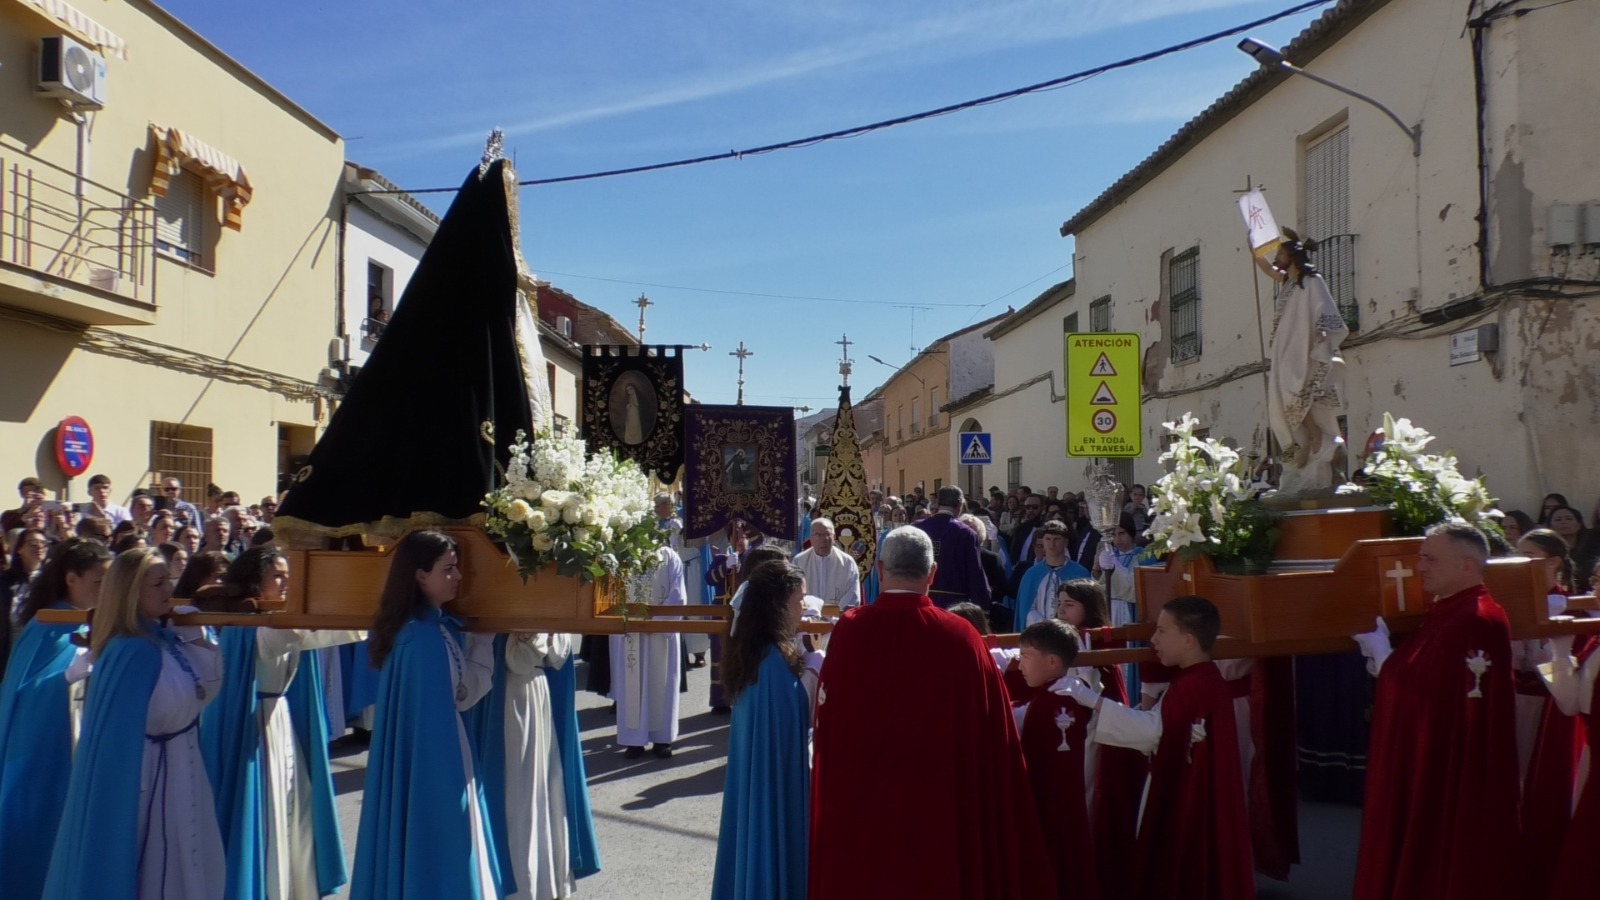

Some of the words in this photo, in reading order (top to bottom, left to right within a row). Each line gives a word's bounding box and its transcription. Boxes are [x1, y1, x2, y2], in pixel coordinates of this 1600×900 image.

[1074, 338, 1132, 347] ATENCIÓN
[1097, 417, 1112, 425] 30
[1091, 444, 1135, 452] TRAVESÍA
